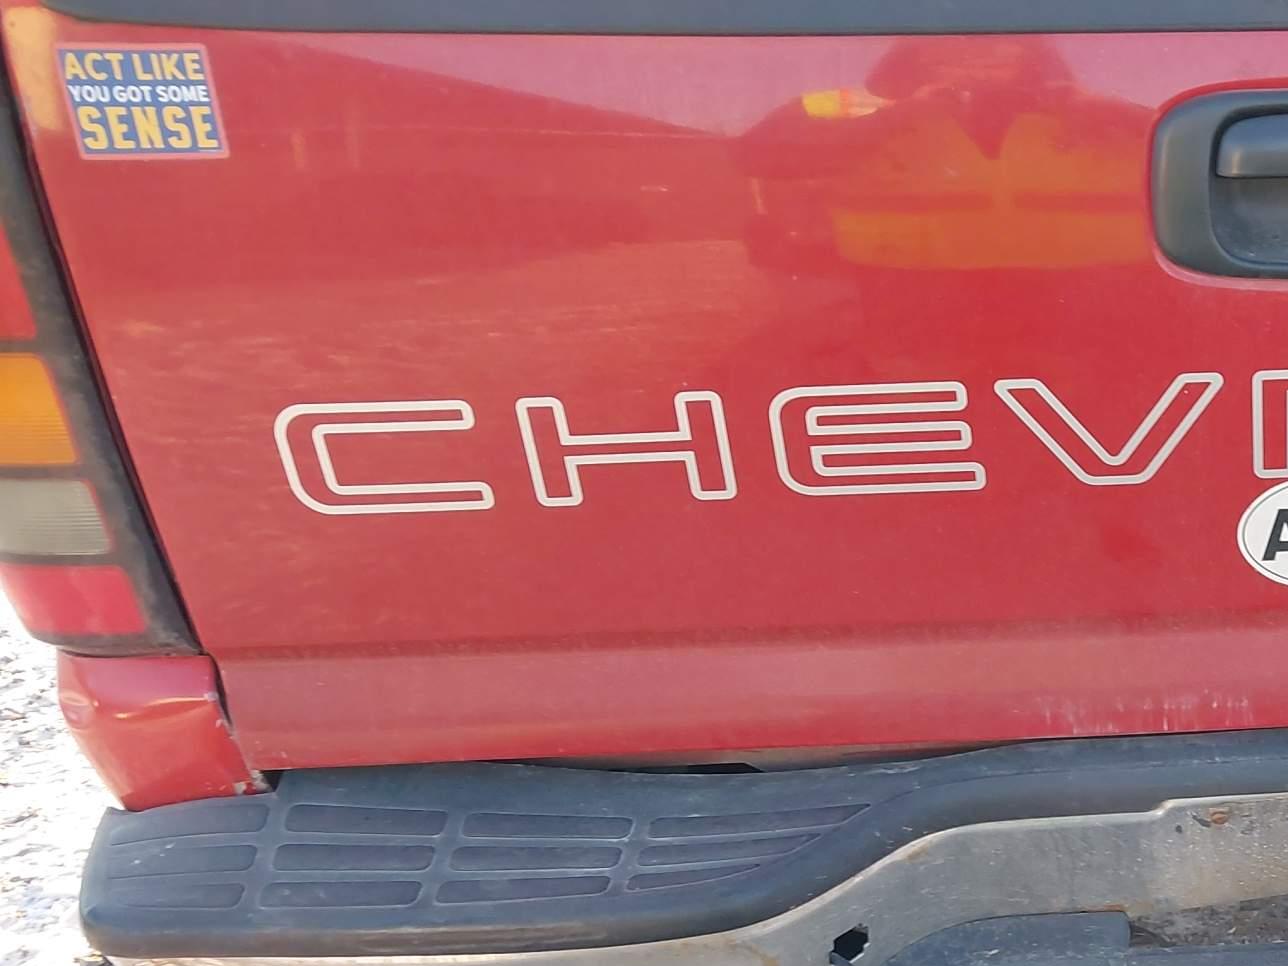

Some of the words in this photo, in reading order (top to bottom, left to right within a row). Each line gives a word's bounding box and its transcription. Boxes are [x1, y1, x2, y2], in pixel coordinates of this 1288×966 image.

[64, 52, 124, 81] ACT
[131, 52, 205, 81] LIKE
[67, 84, 111, 103] YOU
[112, 84, 153, 103] GOT
[155, 84, 211, 103] SOME
[76, 105, 219, 150] SENSE
